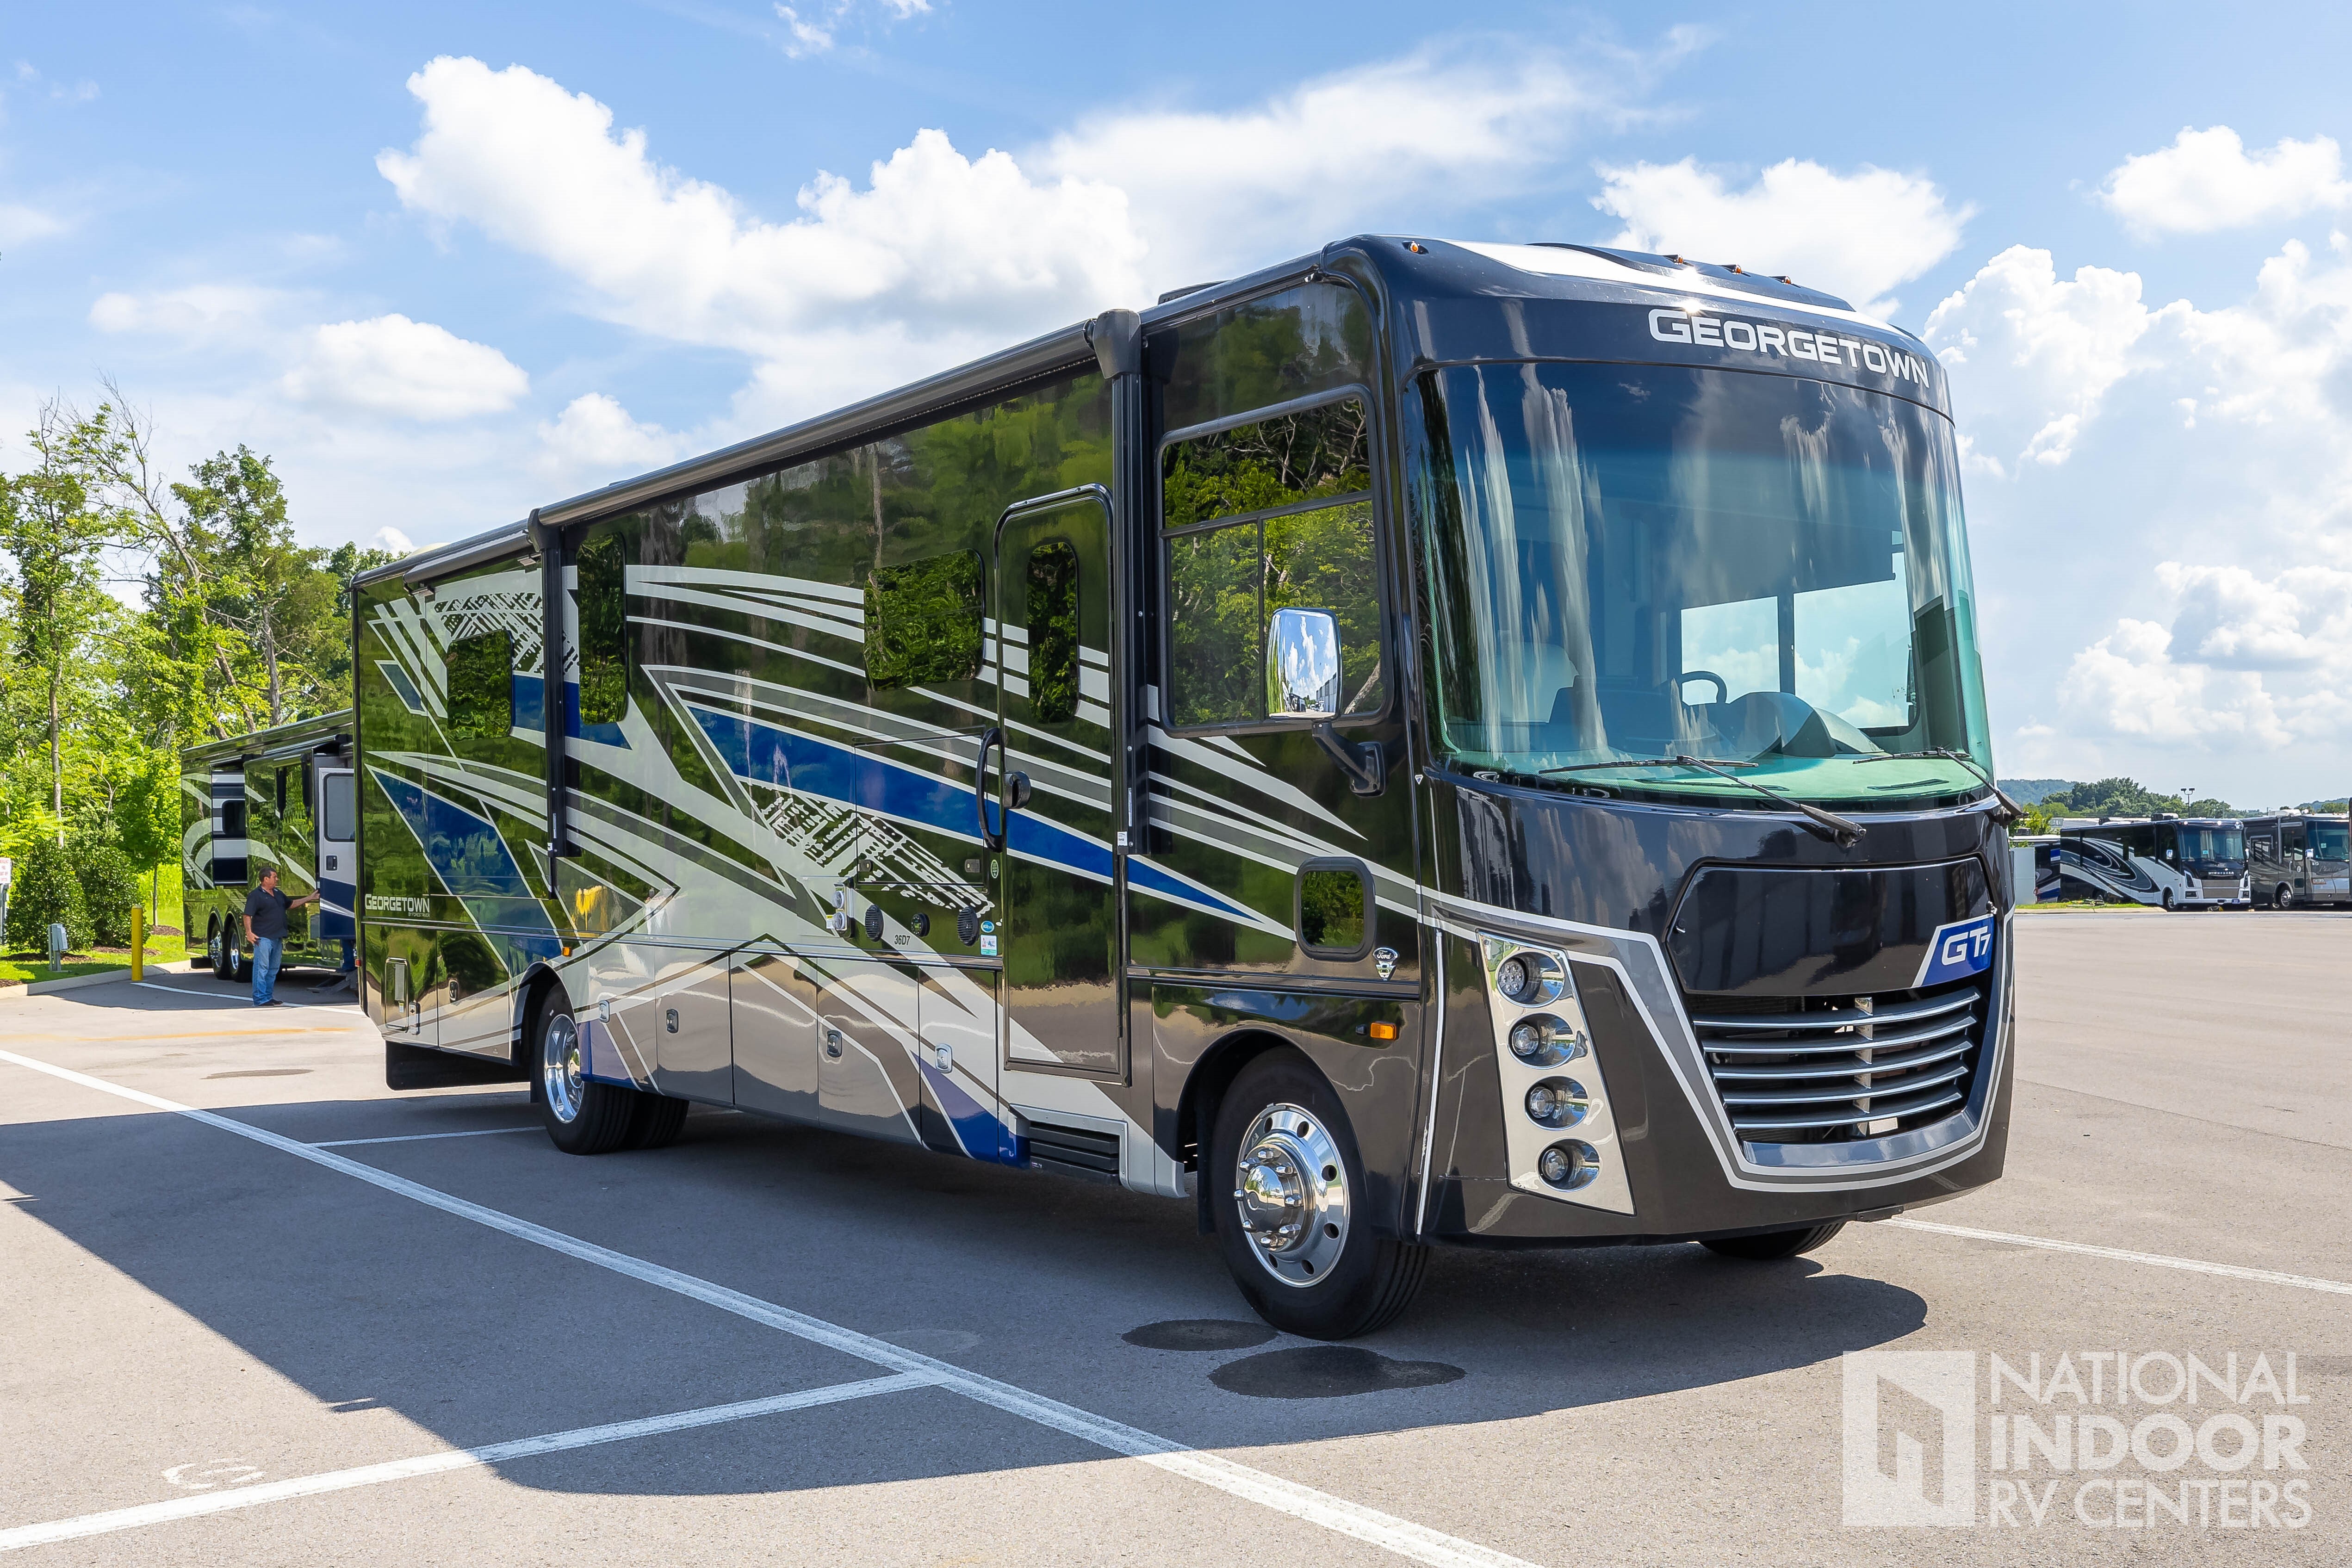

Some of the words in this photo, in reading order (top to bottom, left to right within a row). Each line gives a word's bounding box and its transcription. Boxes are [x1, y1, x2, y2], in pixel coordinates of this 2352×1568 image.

[1648, 309, 1930, 388] GEORGETOWN
[365, 893, 430, 912] GEORGETOWN
[894, 935, 910, 945] 36D7
[1942, 925, 1991, 966] GT7
[1377, 950, 1391, 960] Ford
